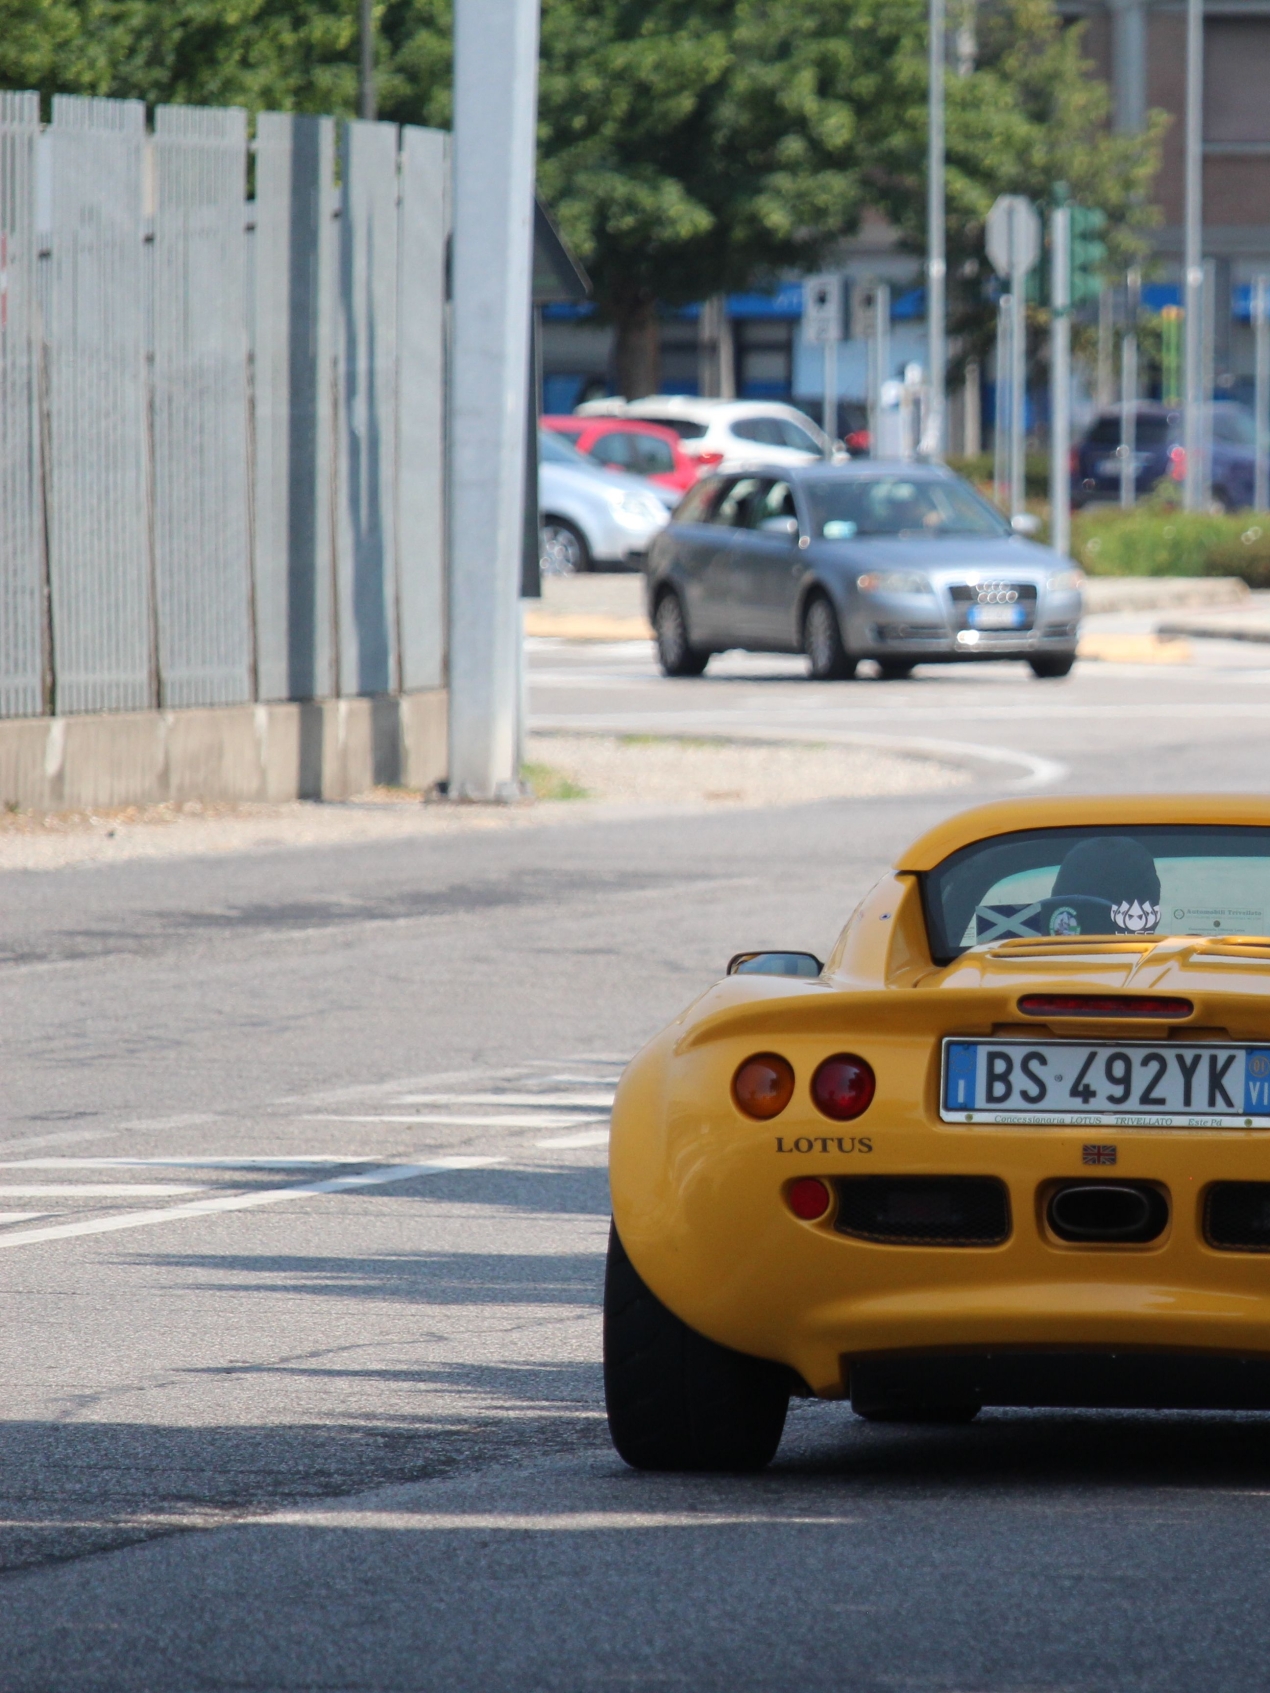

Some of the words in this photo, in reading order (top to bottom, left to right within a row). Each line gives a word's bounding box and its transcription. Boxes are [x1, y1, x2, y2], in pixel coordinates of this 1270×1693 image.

[985, 1051, 1048, 1104] BS
[1069, 1051, 1237, 1108] 492YK
[1249, 1081, 1269, 1106] VI
[994, 1114, 1065, 1124] Concessionaria
[1070, 1116, 1102, 1125] LOTUS
[1114, 1116, 1173, 1127] TRIVELLATO
[1188, 1118, 1208, 1127] Este
[1209, 1118, 1223, 1127] Pd
[775, 1136, 873, 1154] LOTUS
